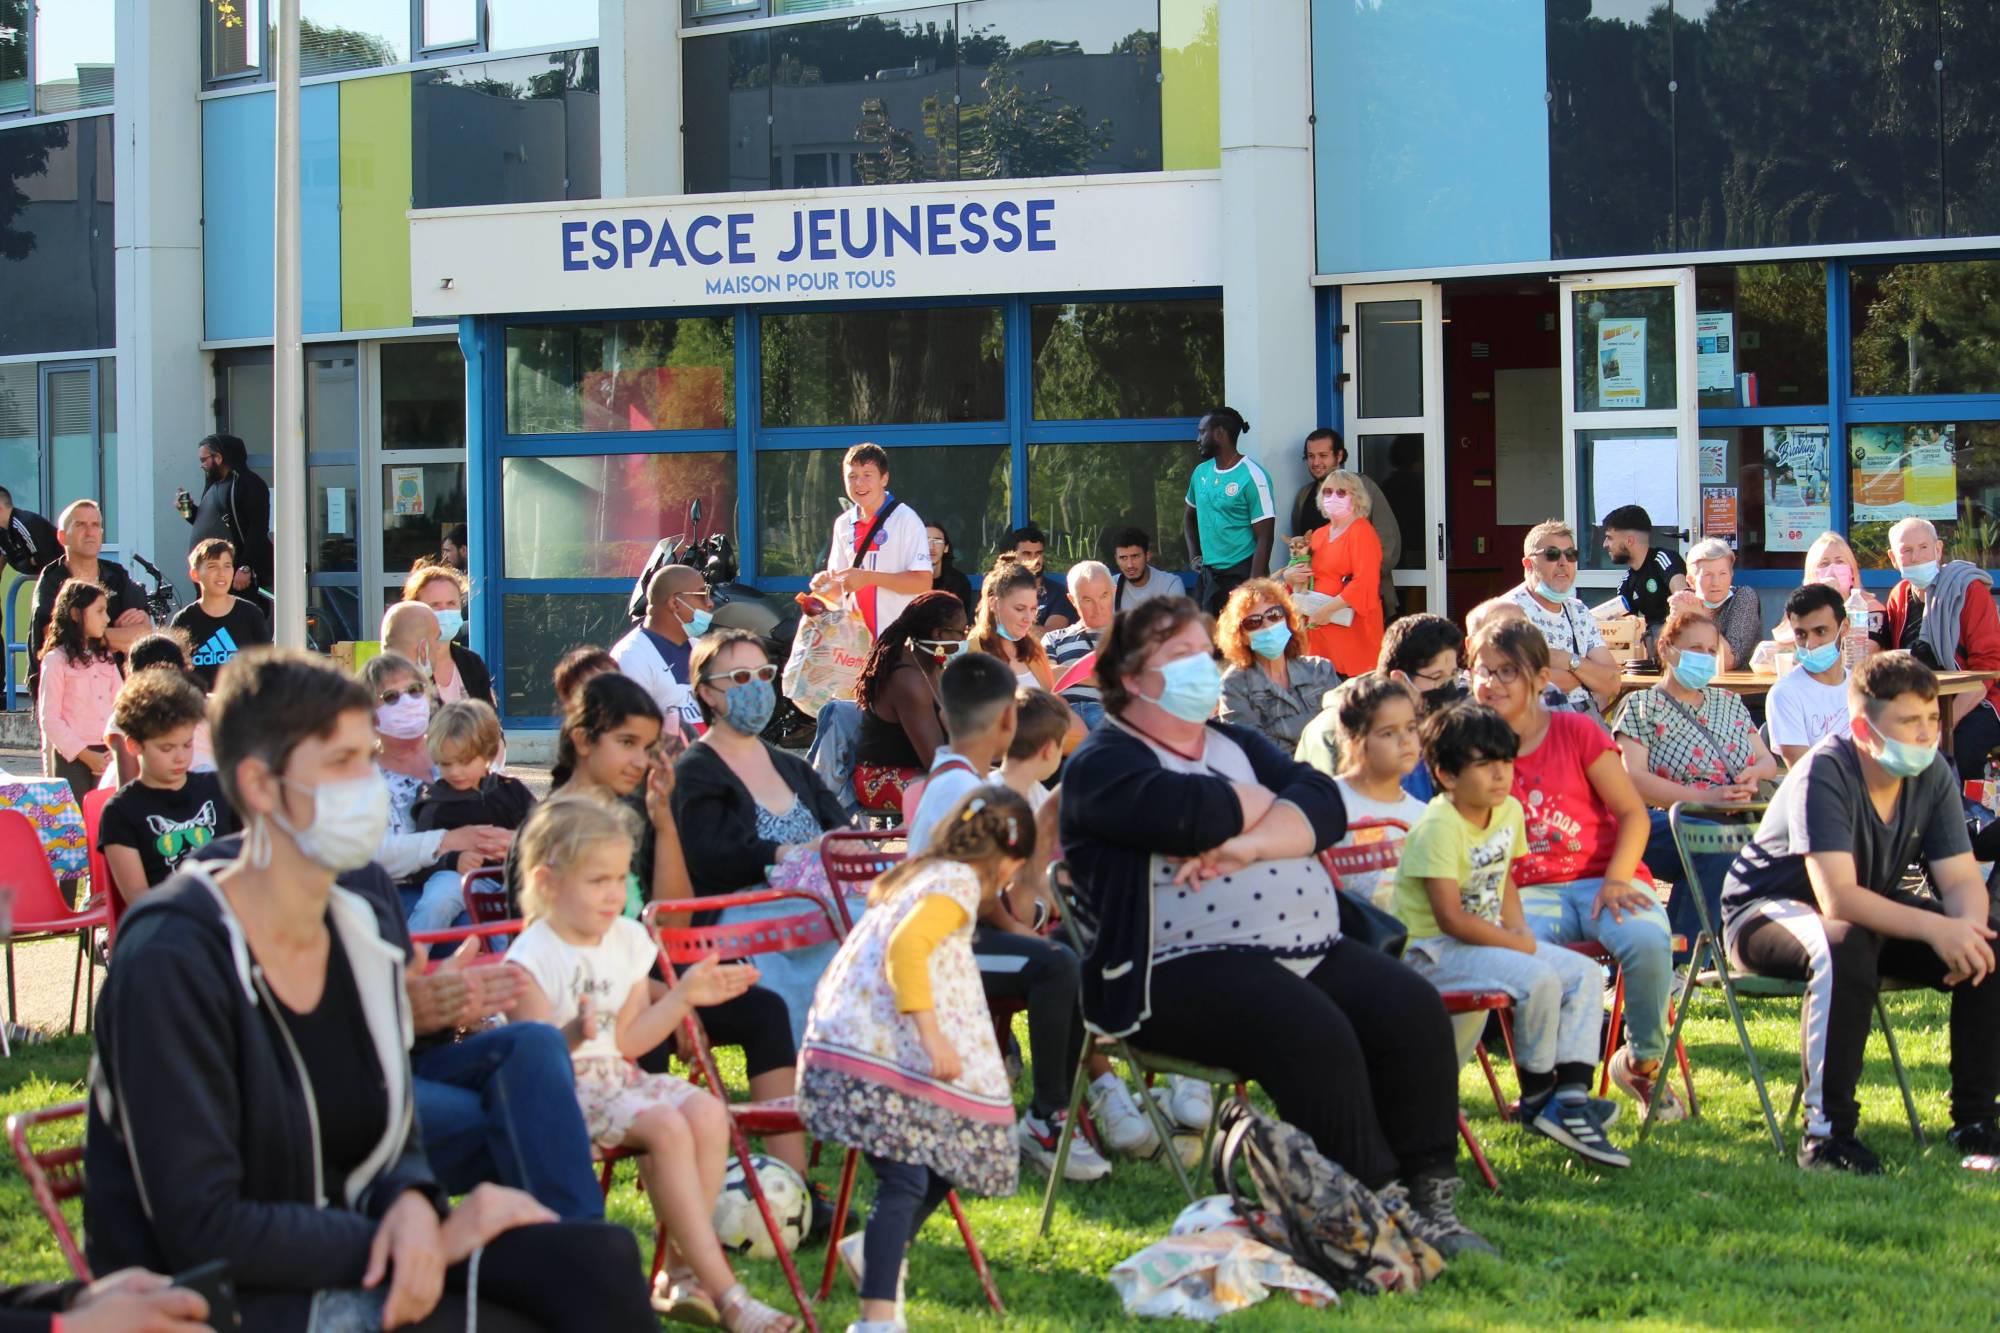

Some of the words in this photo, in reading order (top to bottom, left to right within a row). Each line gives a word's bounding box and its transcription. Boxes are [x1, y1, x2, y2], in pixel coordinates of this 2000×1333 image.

[562, 213, 756, 272] ESPACE
[776, 199, 1056, 263] JEUNESSE
[705, 274, 781, 295] MAISON
[786, 271, 839, 292] POUR
[845, 269, 896, 290] TOUS
[1777, 439, 1816, 464] Breaking
[192, 650, 234, 666] adid
